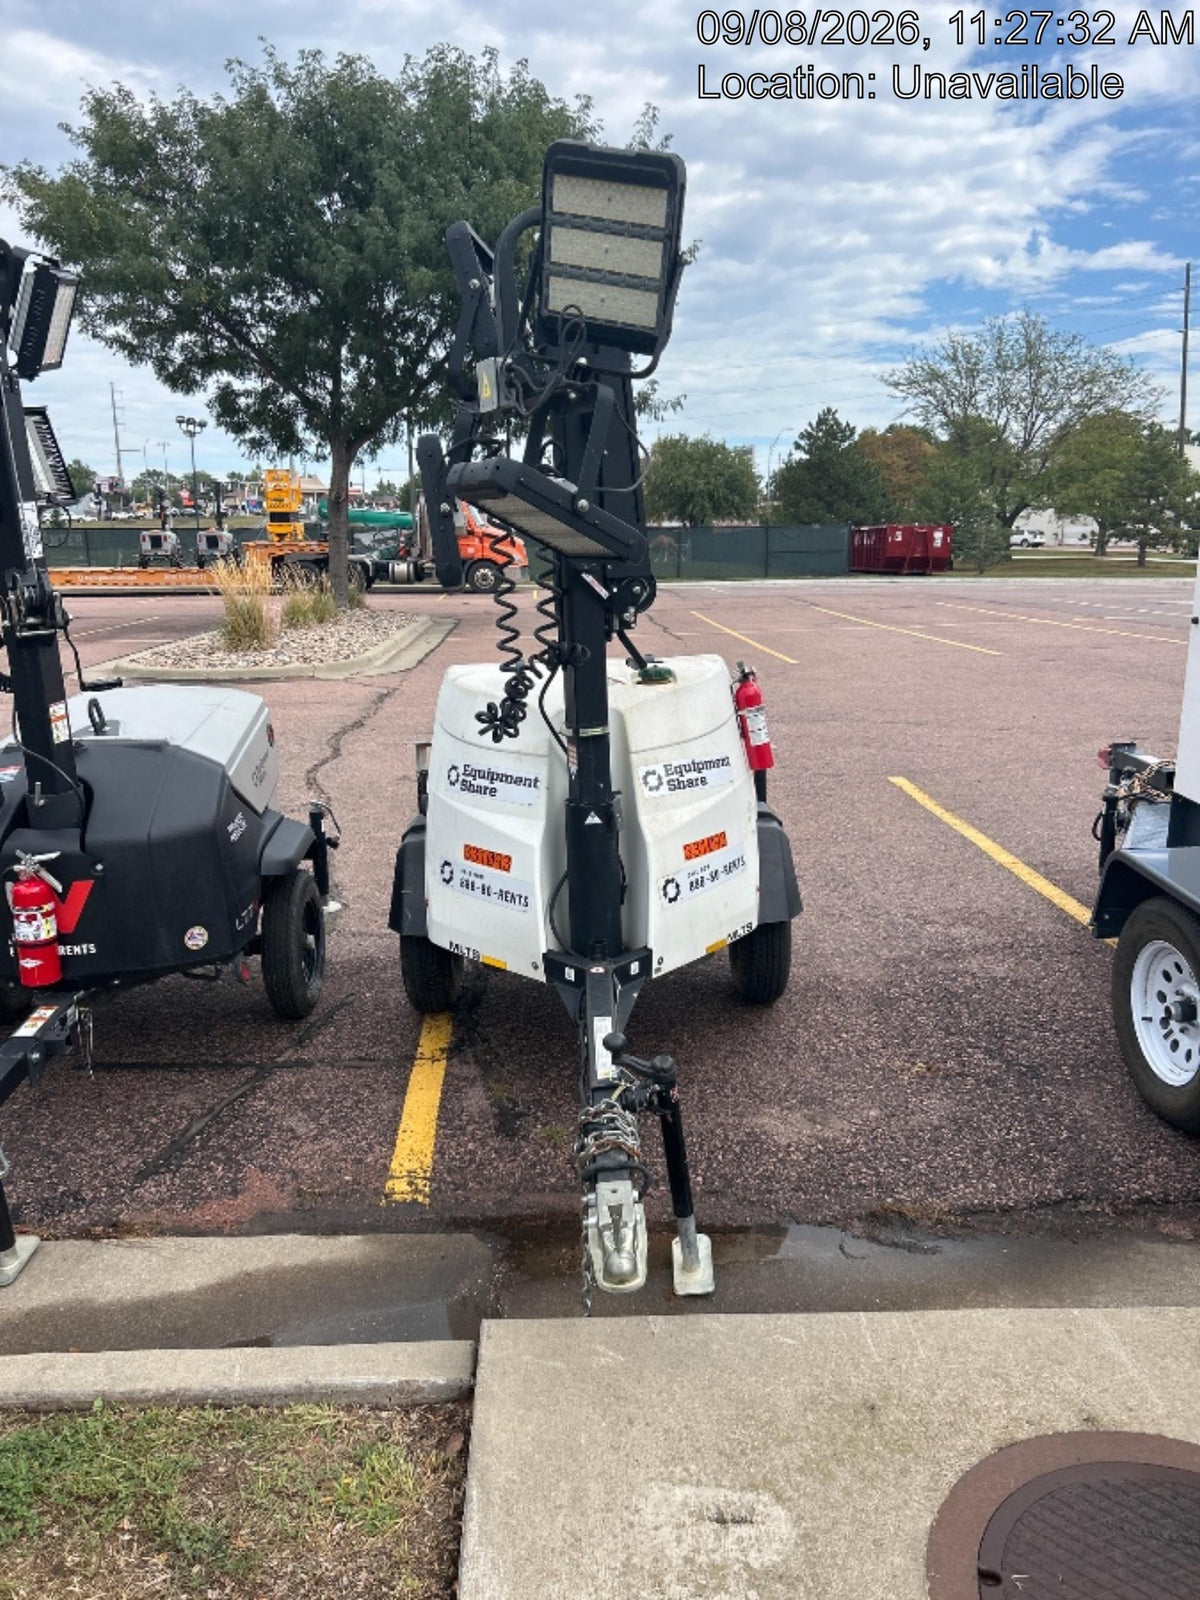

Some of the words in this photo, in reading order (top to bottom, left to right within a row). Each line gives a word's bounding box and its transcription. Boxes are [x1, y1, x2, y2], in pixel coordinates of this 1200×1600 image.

[462, 764, 540, 790] Equipment
[666, 775, 708, 792] Share
[460, 779, 498, 798] Share
